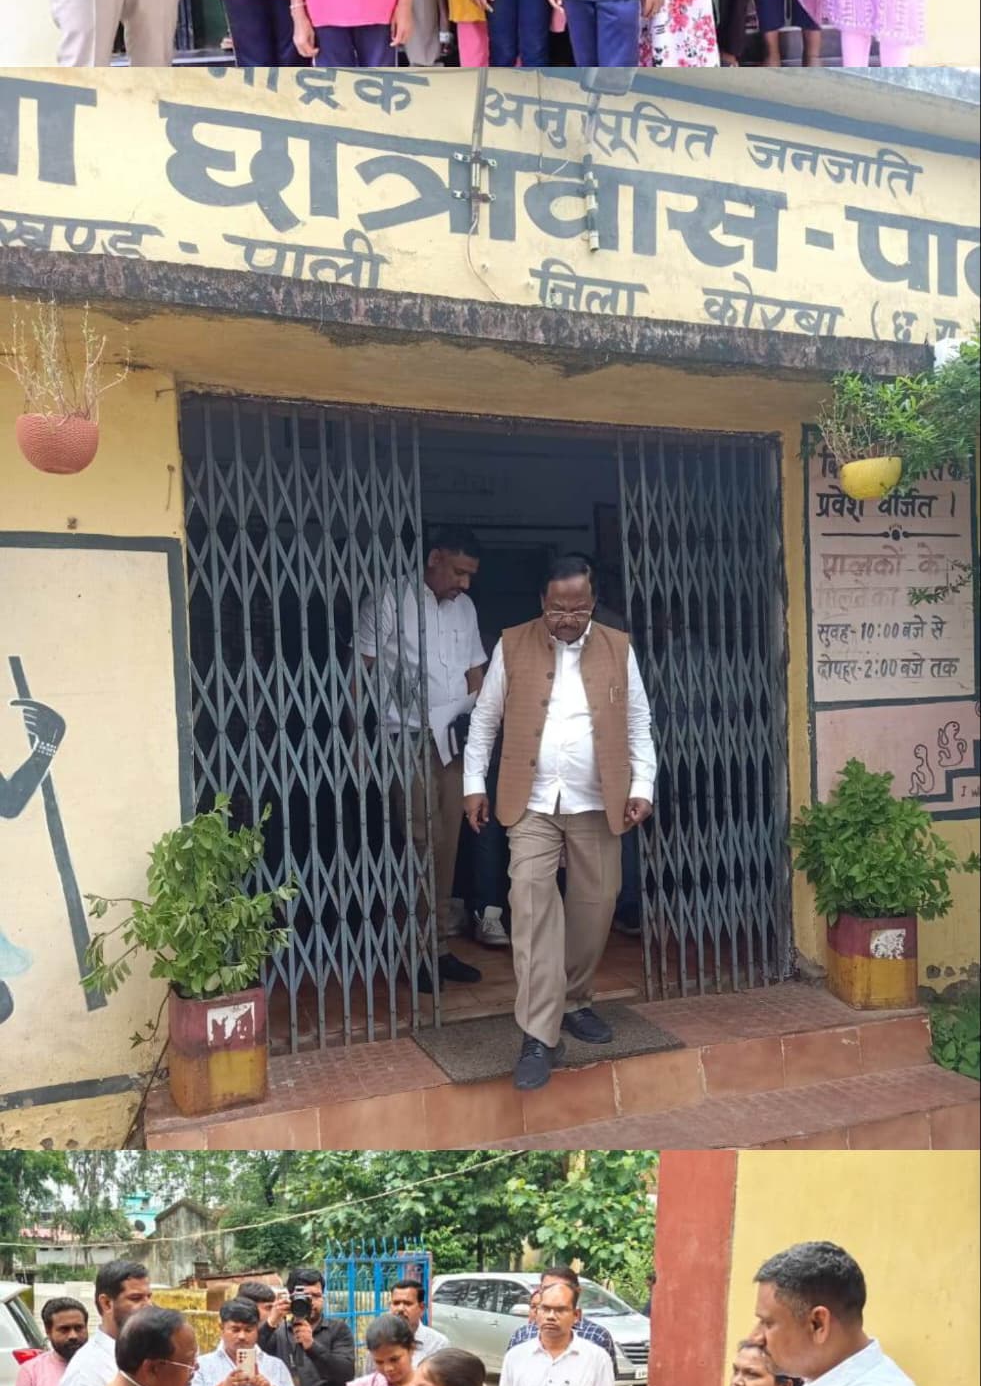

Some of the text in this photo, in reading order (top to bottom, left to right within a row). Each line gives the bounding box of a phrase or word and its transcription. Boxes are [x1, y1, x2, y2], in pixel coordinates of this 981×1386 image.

[485, 87, 719, 163] अनुसूचित
[746, 132, 923, 196] जनजाति
[222, 229, 391, 290] पाली
[703, 272, 845, 336] कोरबा
[816, 485, 864, 522] प्रवेश
[902, 614, 927, 639] बजे
[931, 615, 946, 639] से
[900, 652, 926, 678] बजे
[930, 657, 960, 678] तक
